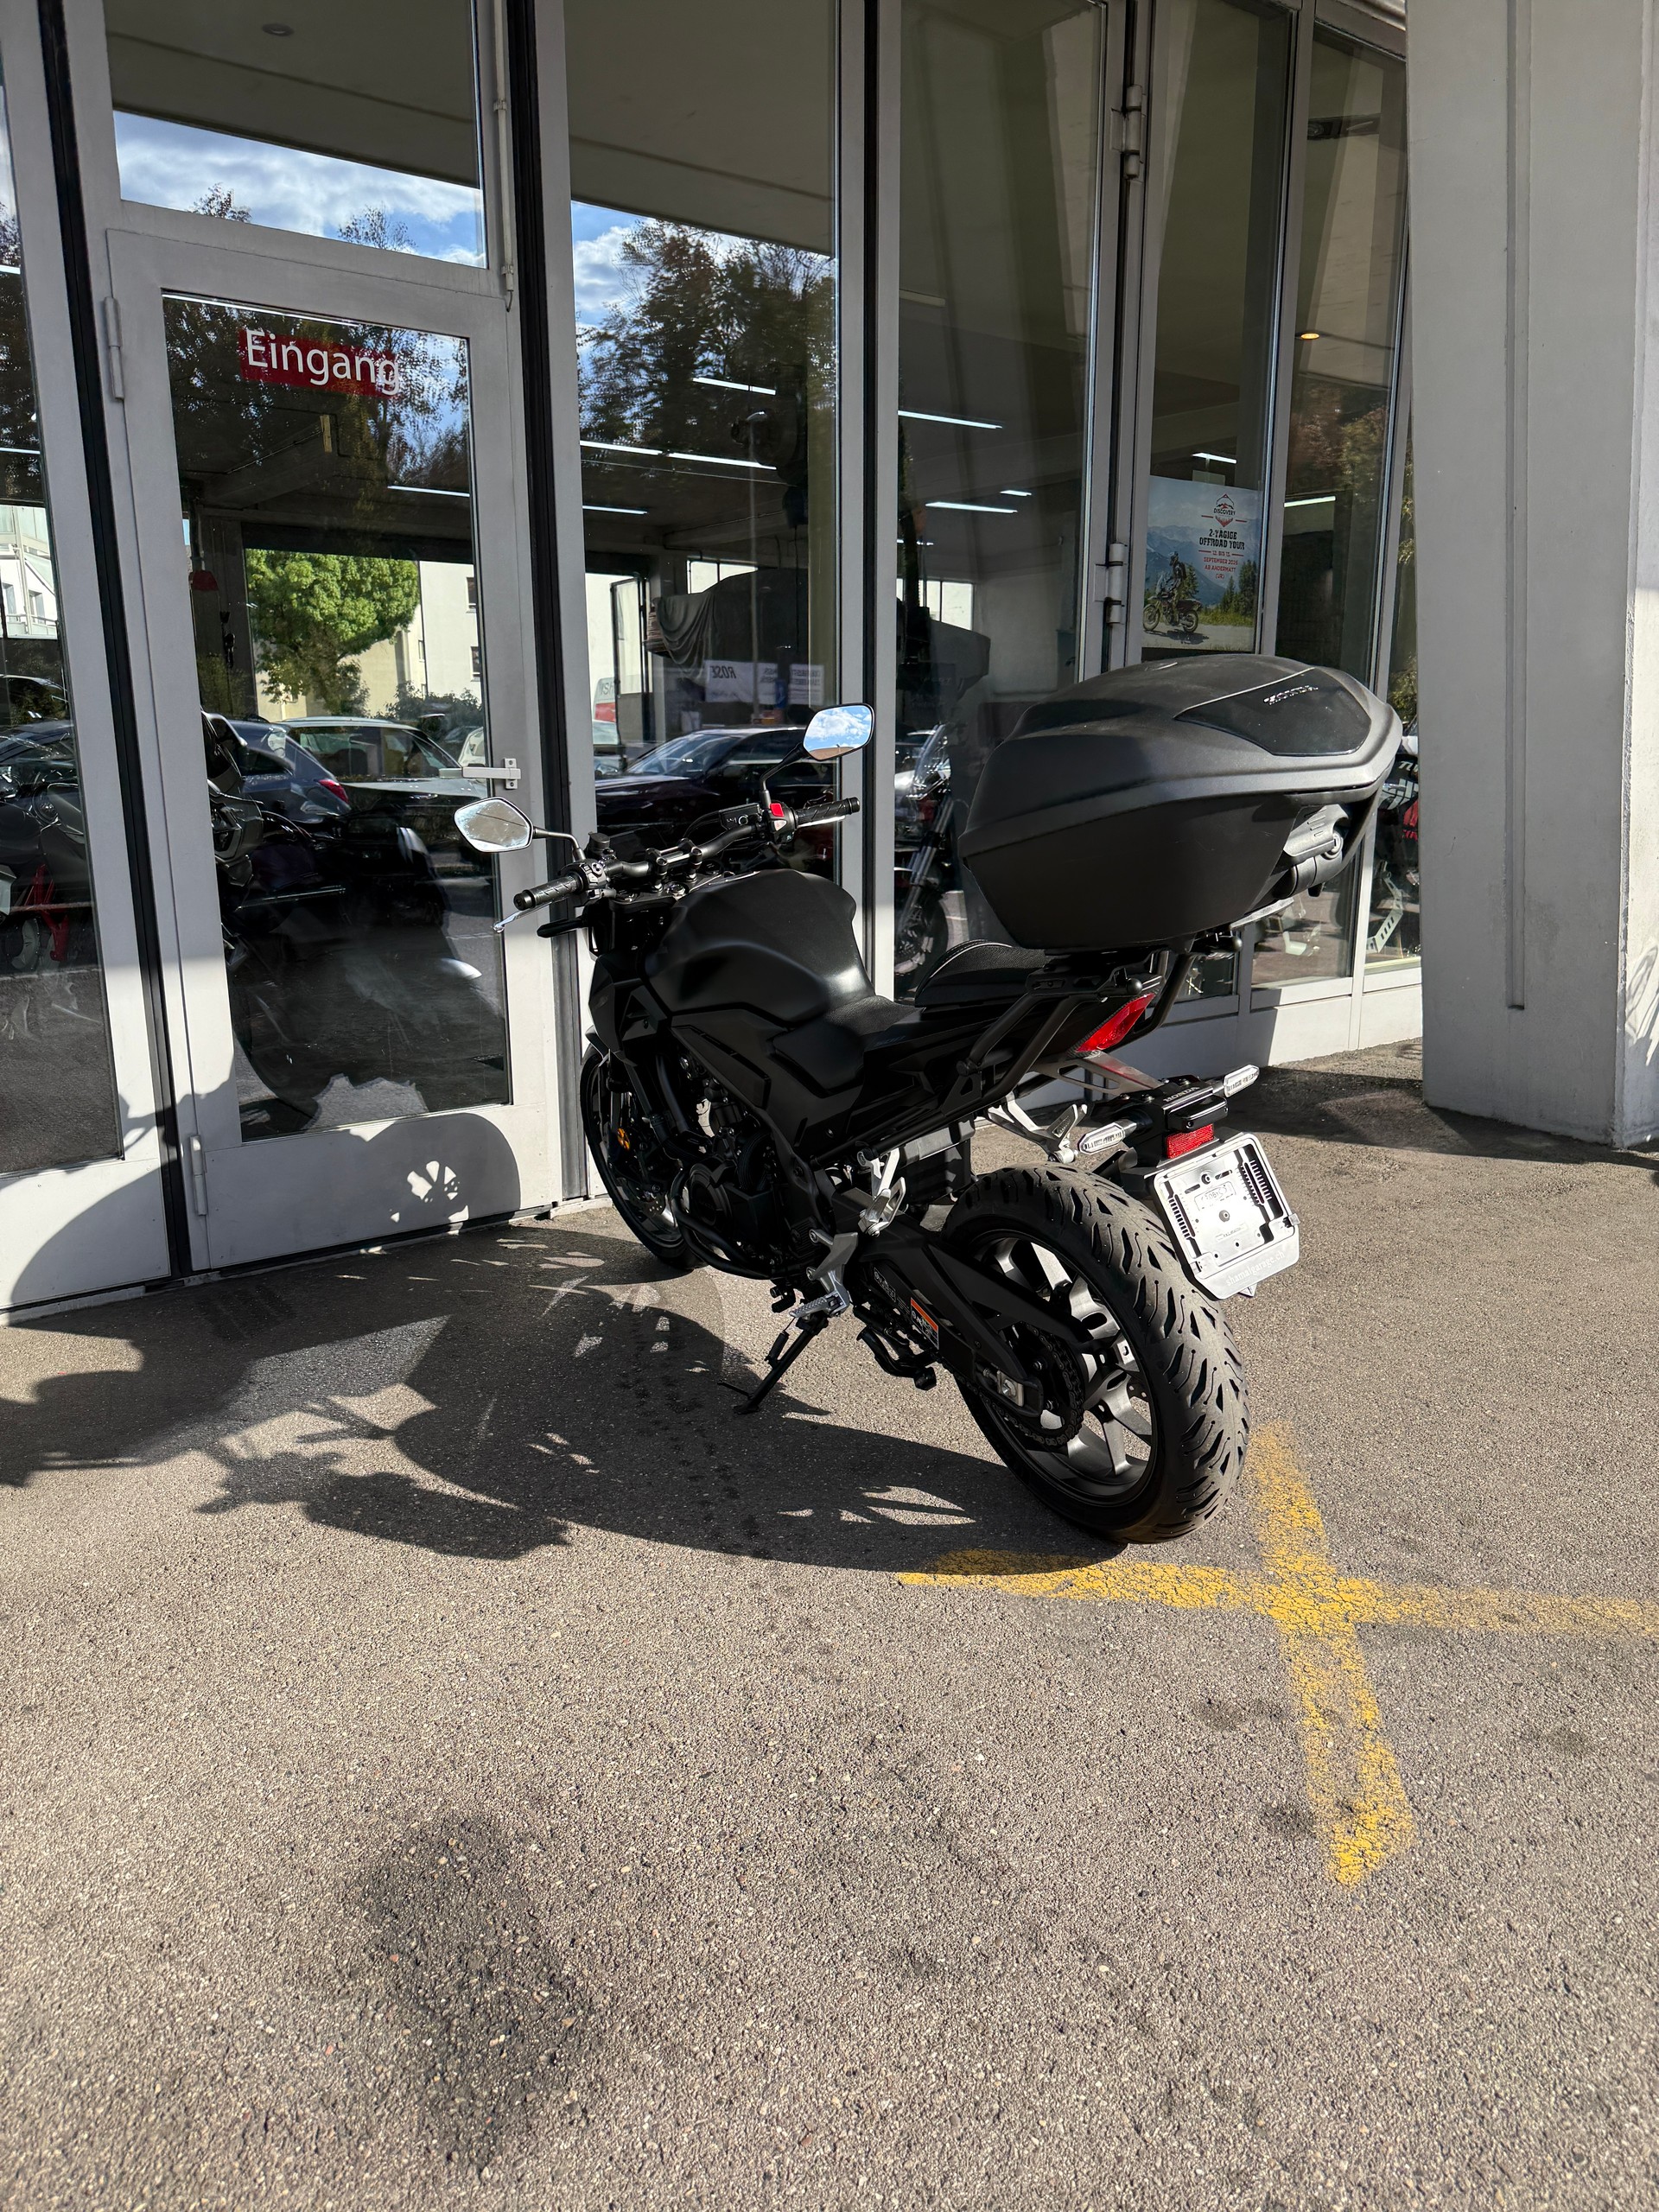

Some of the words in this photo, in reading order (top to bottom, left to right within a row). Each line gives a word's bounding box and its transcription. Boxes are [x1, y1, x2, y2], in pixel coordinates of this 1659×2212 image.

[246, 328, 400, 396] Eingang
[1199, 537, 1228, 548] OFFROAD
[1229, 541, 1245, 550] TOUR
[1162, 1086, 1200, 1103] HONDA
[1225, 1249, 1286, 1287] shamalgarage.ch
